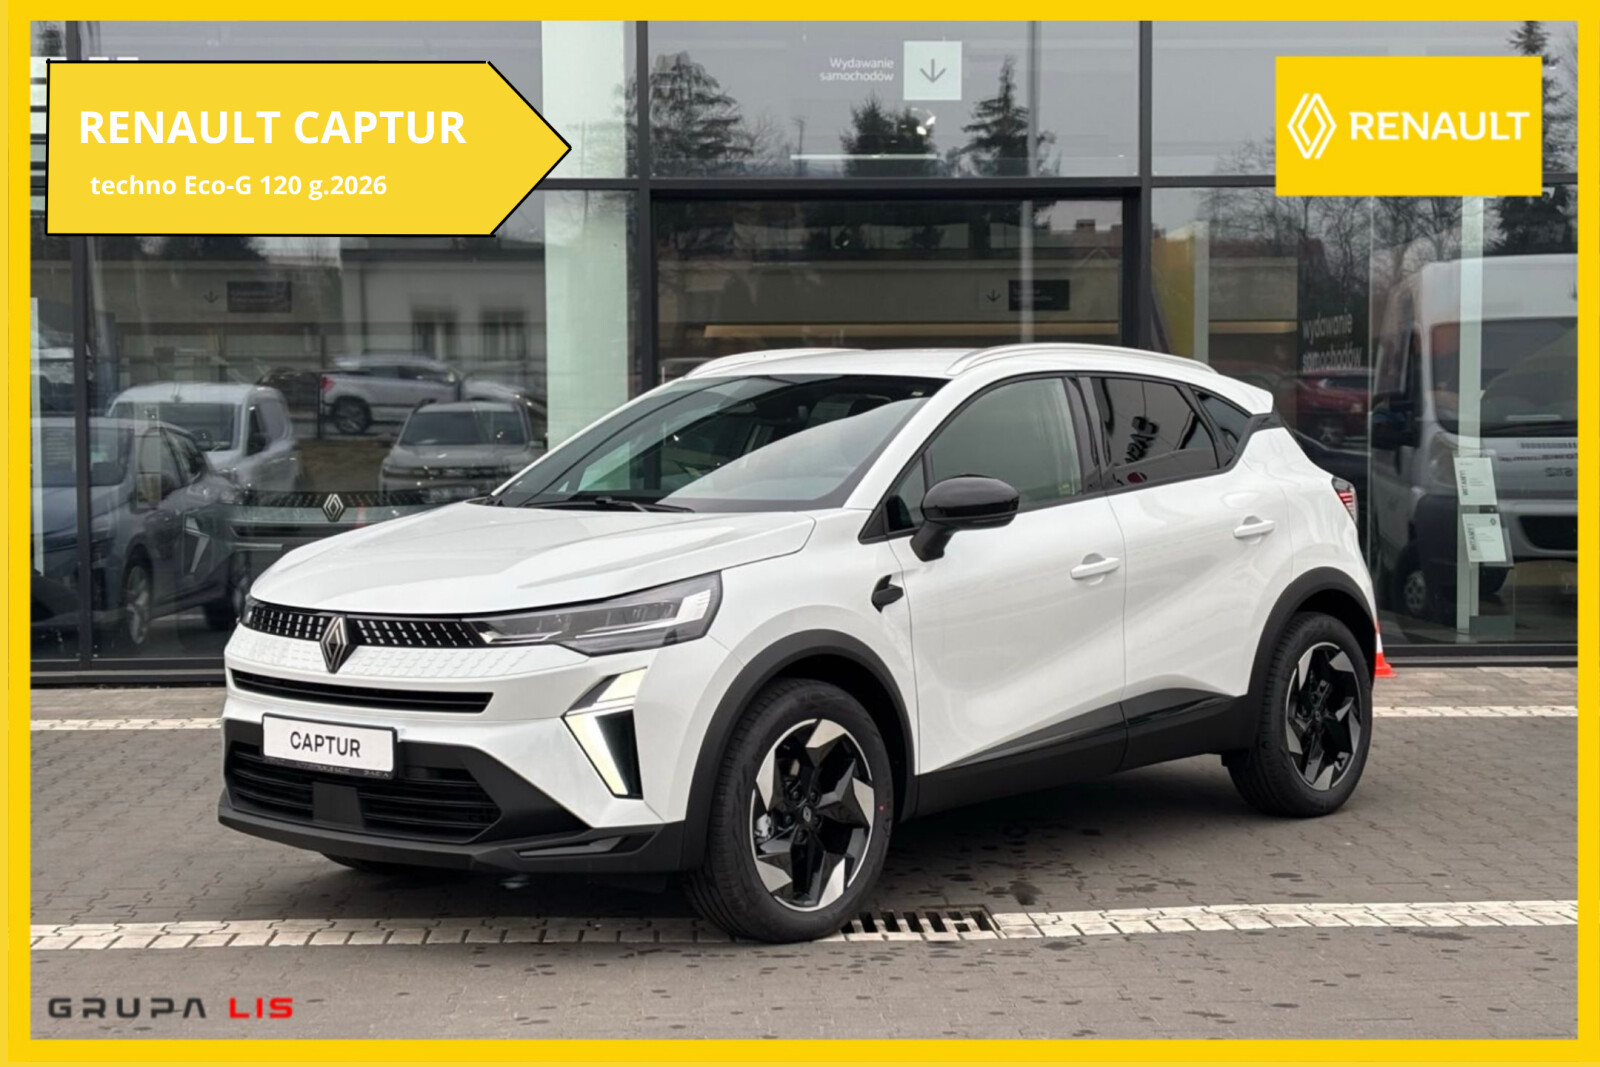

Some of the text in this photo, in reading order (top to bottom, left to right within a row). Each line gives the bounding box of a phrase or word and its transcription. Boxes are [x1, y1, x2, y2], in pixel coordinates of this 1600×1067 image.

[820, 69, 895, 83] samochodów
[829, 57, 895, 71] Wydawanie
[1302, 308, 1353, 345] wydawanie
[1303, 341, 1363, 371] samochodów
[290, 730, 361, 758] CAPTUR
